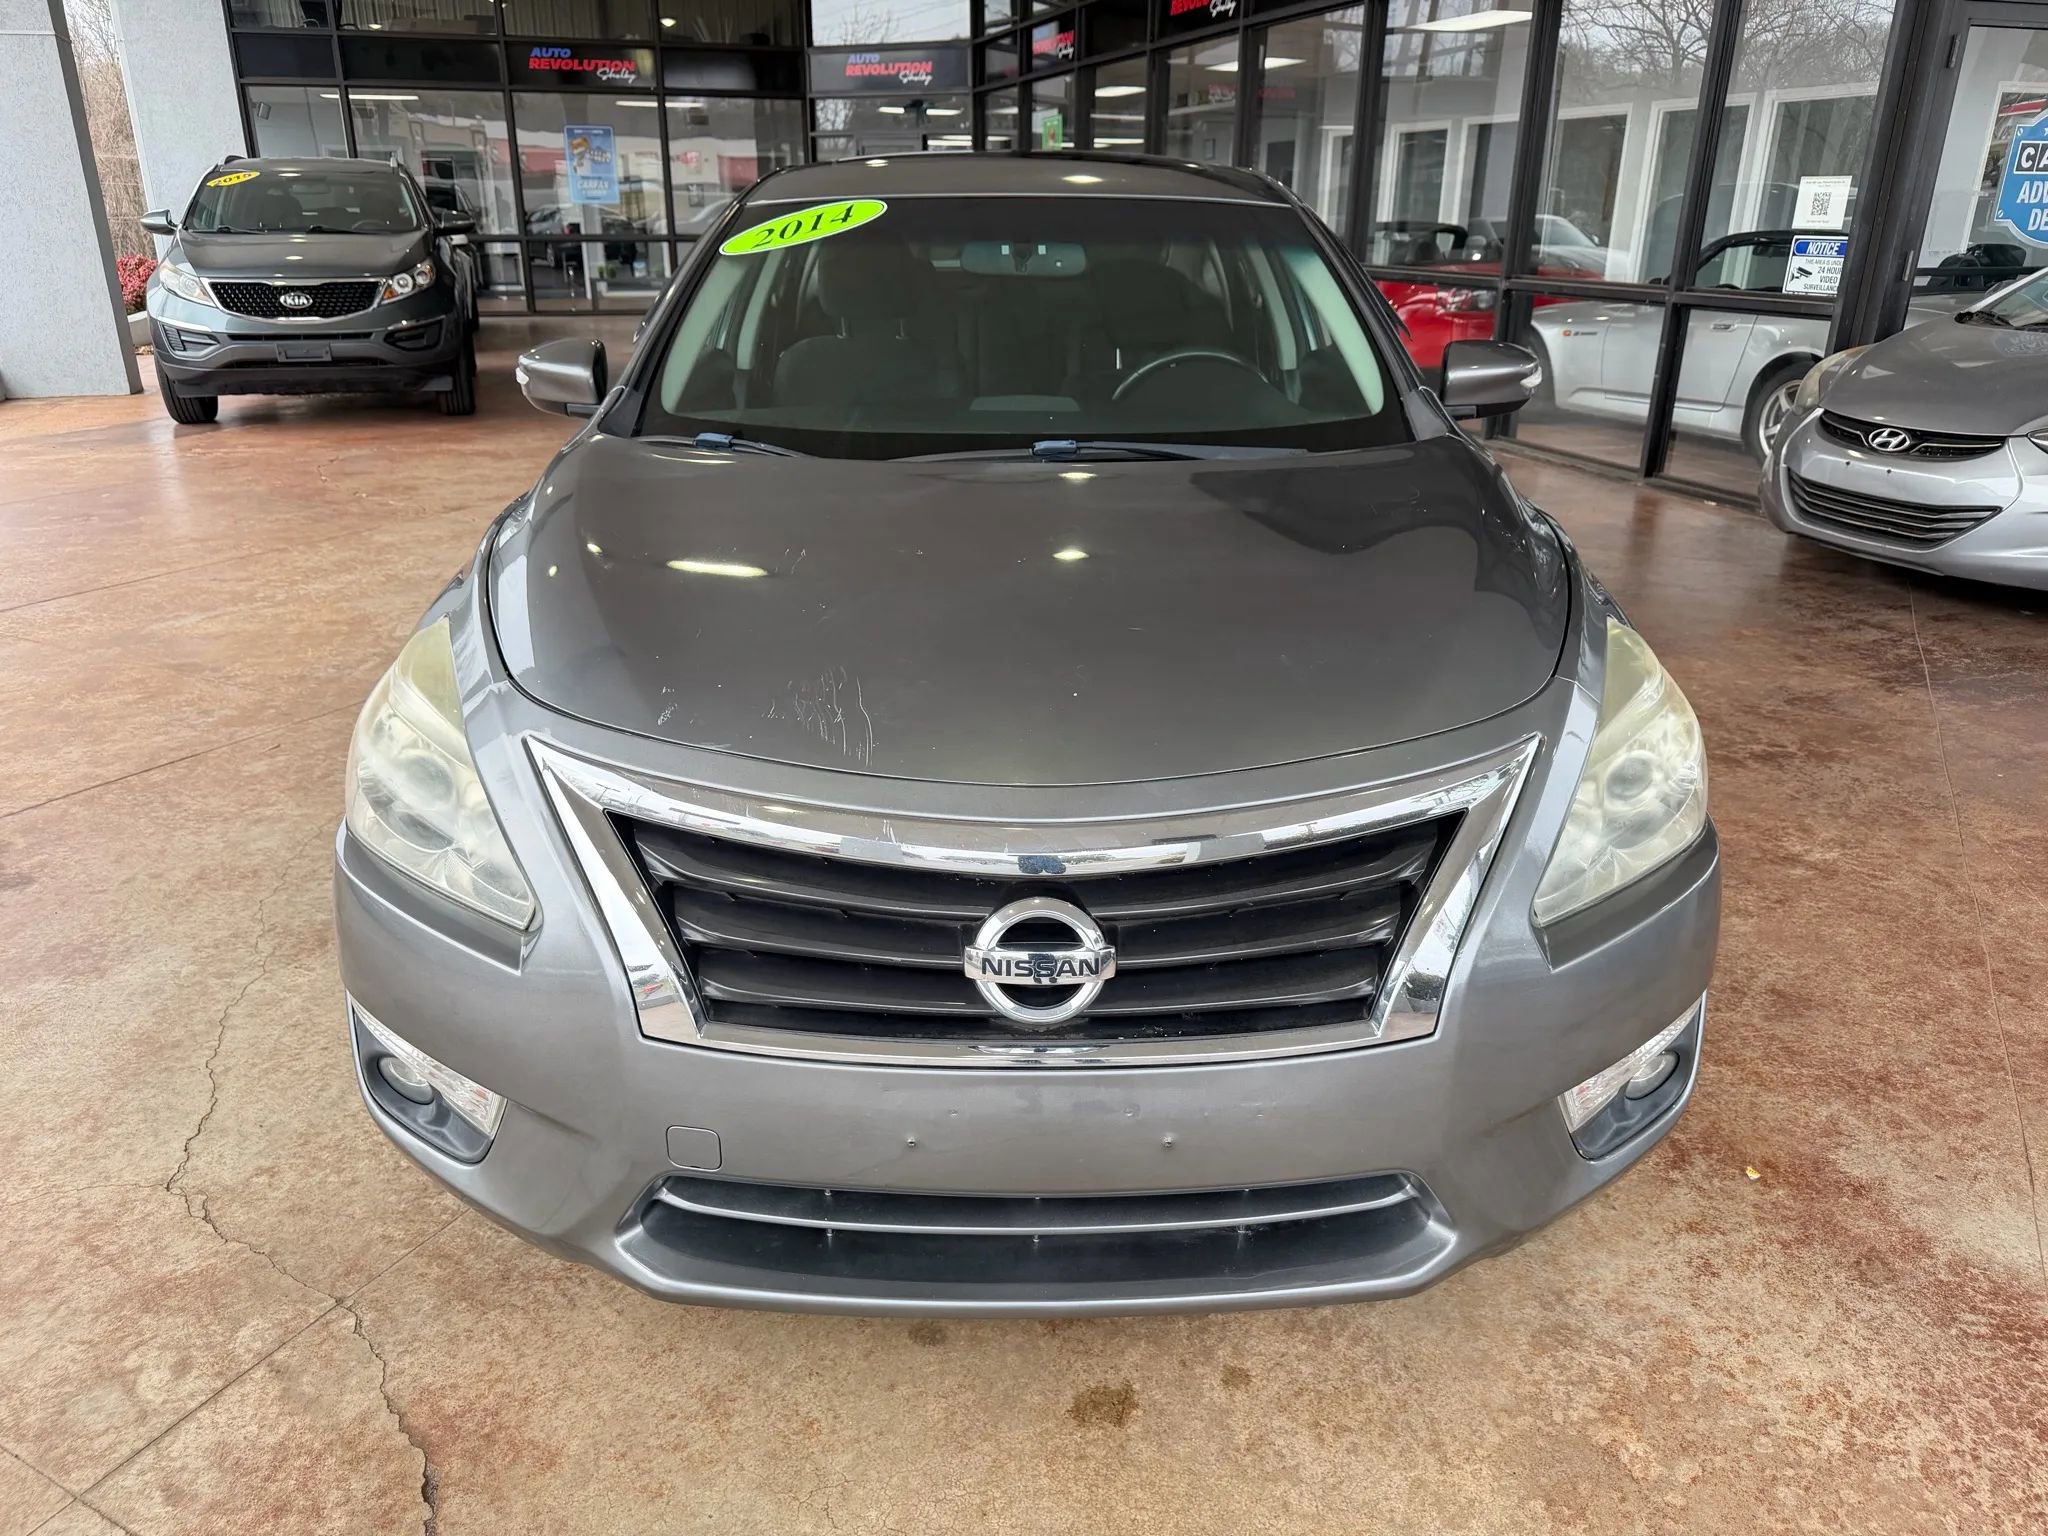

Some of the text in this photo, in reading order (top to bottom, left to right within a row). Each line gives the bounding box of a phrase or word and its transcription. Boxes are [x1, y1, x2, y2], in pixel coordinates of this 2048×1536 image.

[530, 47, 572, 58] AUTO
[847, 53, 881, 64] AUTO
[528, 58, 637, 71] REVOLUTION
[846, 61, 933, 76] REVOLUTION
[752, 204, 855, 249] 2014
[1806, 241, 1841, 256] NOTICE
[1817, 266, 1826, 274] 24
[1819, 275, 1839, 284] VIDEO
[981, 957, 1100, 978] NISSAN
